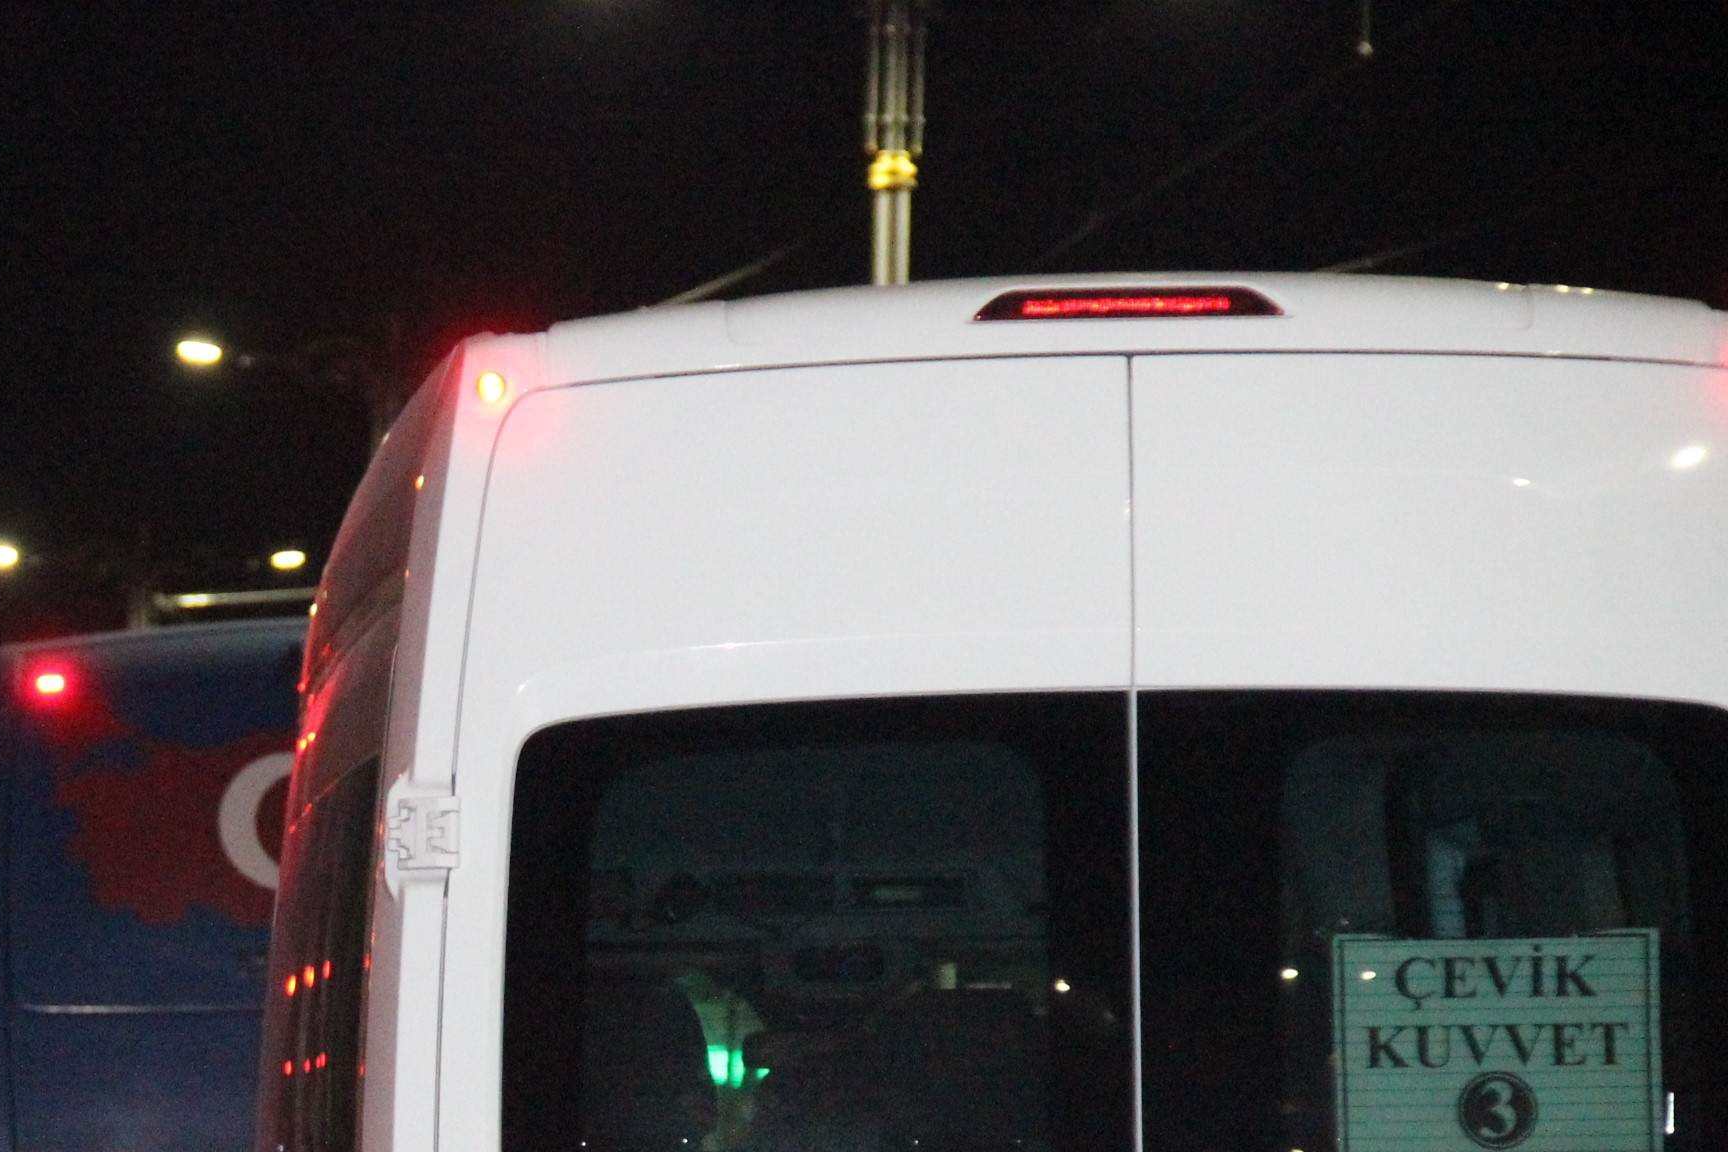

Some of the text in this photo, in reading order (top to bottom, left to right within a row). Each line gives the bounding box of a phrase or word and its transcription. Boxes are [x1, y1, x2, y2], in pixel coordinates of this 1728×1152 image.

[1394, 944, 1598, 1012] ÇEVİK
[1365, 1024, 1628, 1069] KUVVET
[1477, 1080, 1518, 1138] 3
